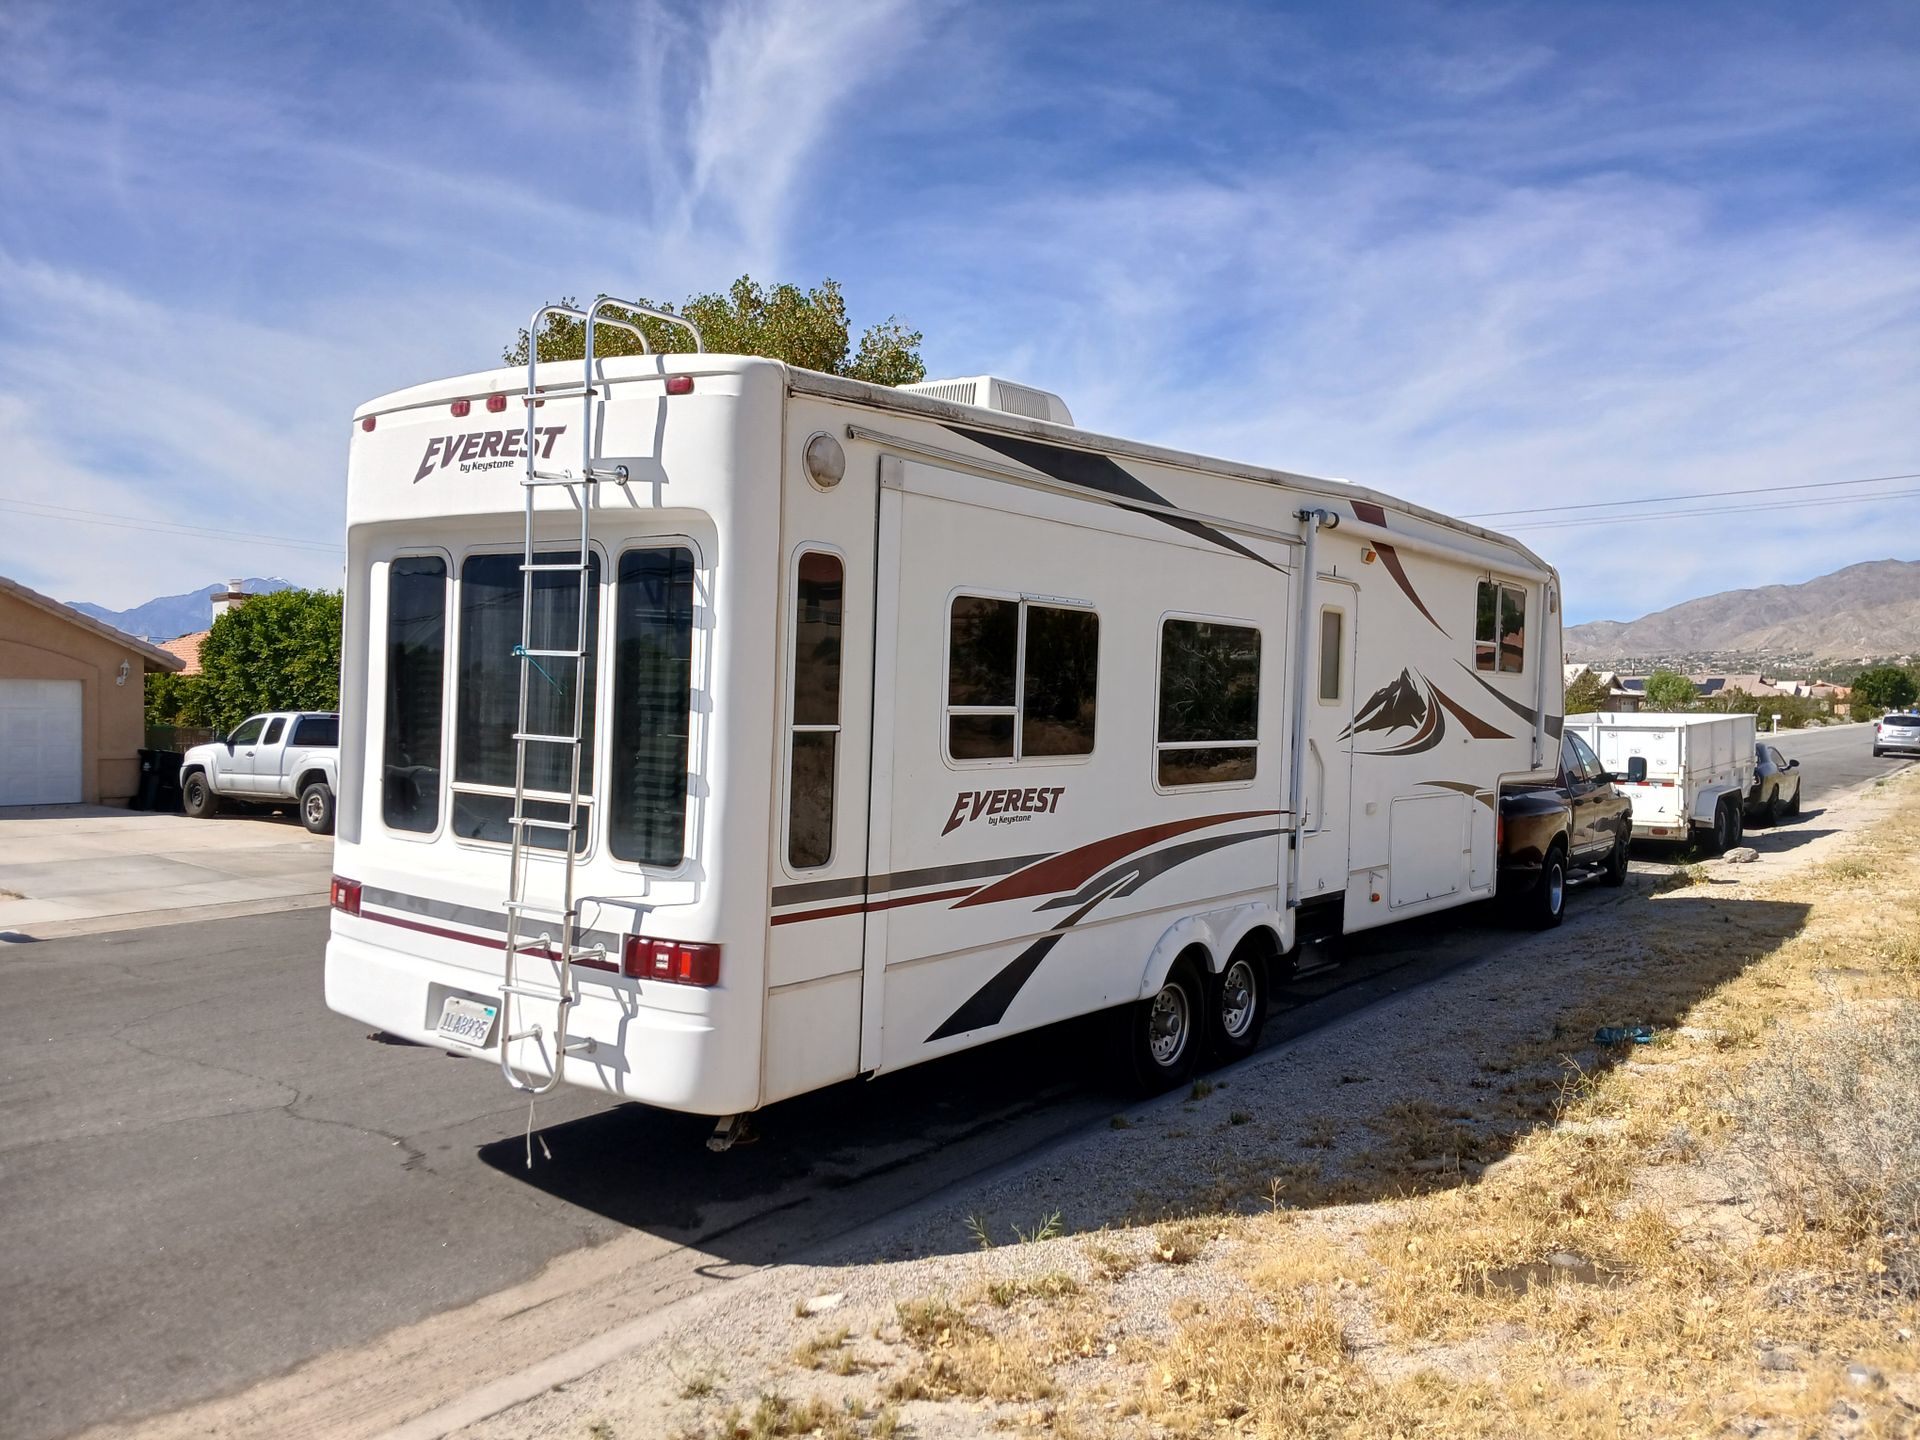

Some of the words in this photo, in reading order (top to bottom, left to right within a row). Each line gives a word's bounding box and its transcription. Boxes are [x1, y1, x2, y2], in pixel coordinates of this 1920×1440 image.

[413, 425, 567, 484] EVEREST
[460, 463, 471, 473] by
[472, 460, 514, 472] Keystone
[941, 787, 1065, 837] EVEREST
[988, 817, 998, 826] by
[999, 815, 1031, 825] Keystone
